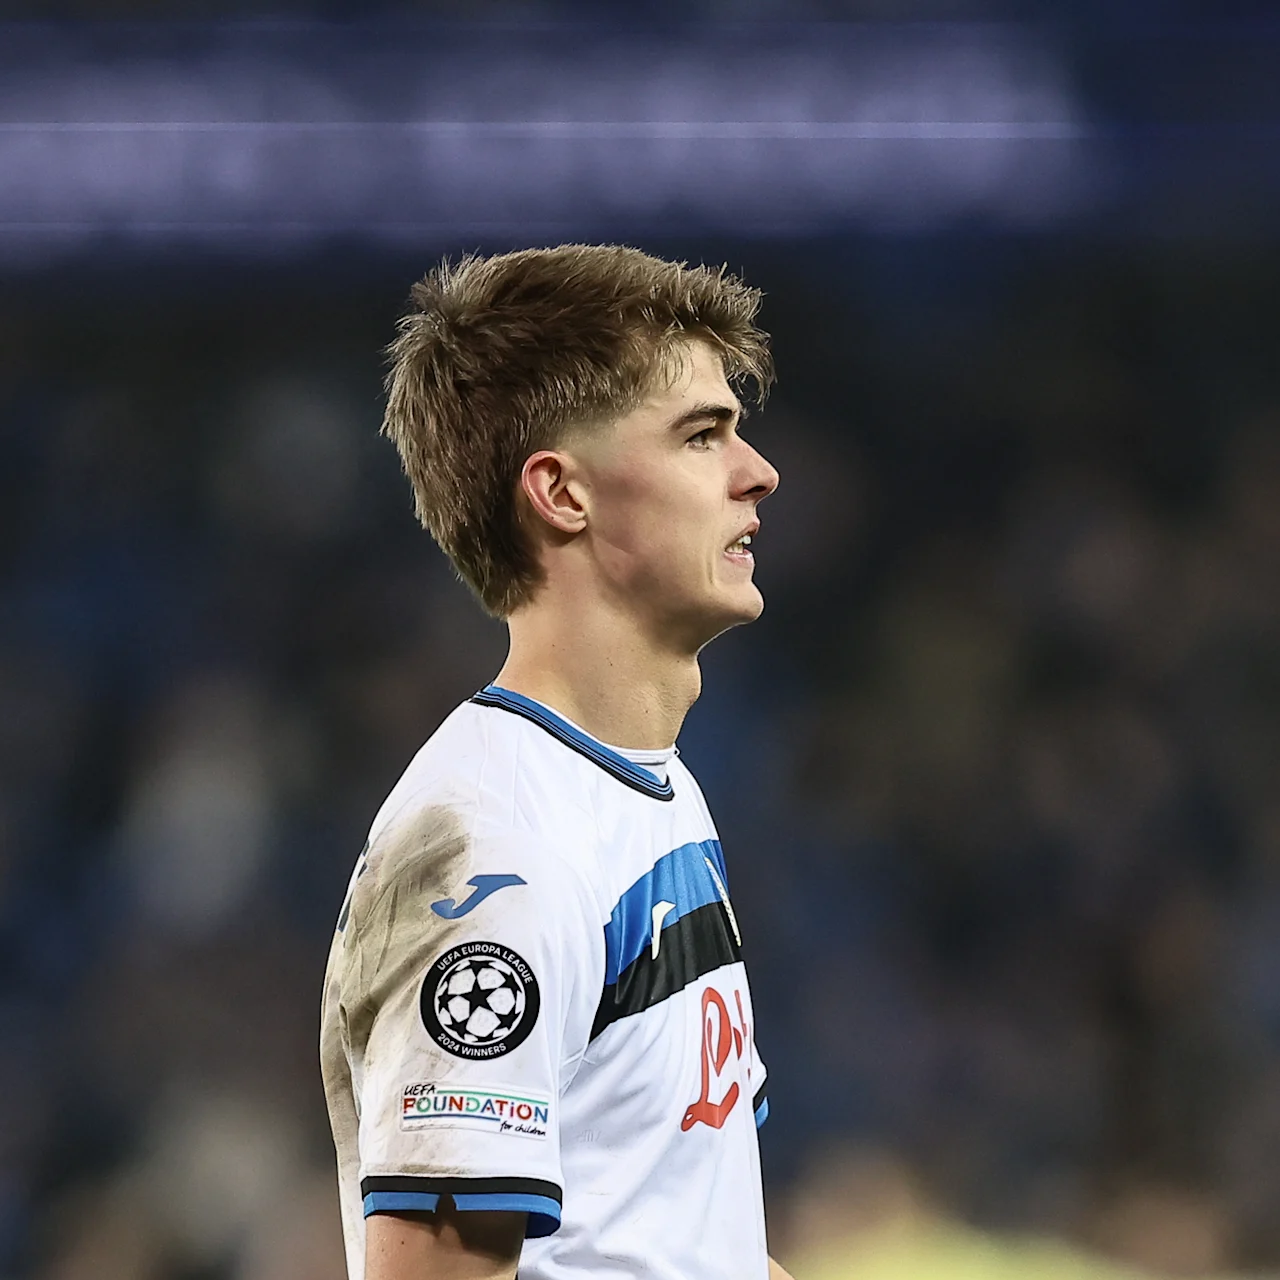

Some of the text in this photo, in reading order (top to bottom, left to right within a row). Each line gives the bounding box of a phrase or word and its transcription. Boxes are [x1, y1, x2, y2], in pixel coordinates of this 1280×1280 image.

[437, 944, 534, 984] UEFA EUROPA LEAGUE
[437, 1033, 507, 1057] 2024 WINNERS
[404, 1083, 437, 1096] UEFA
[500, 1121, 546, 1137] for children
